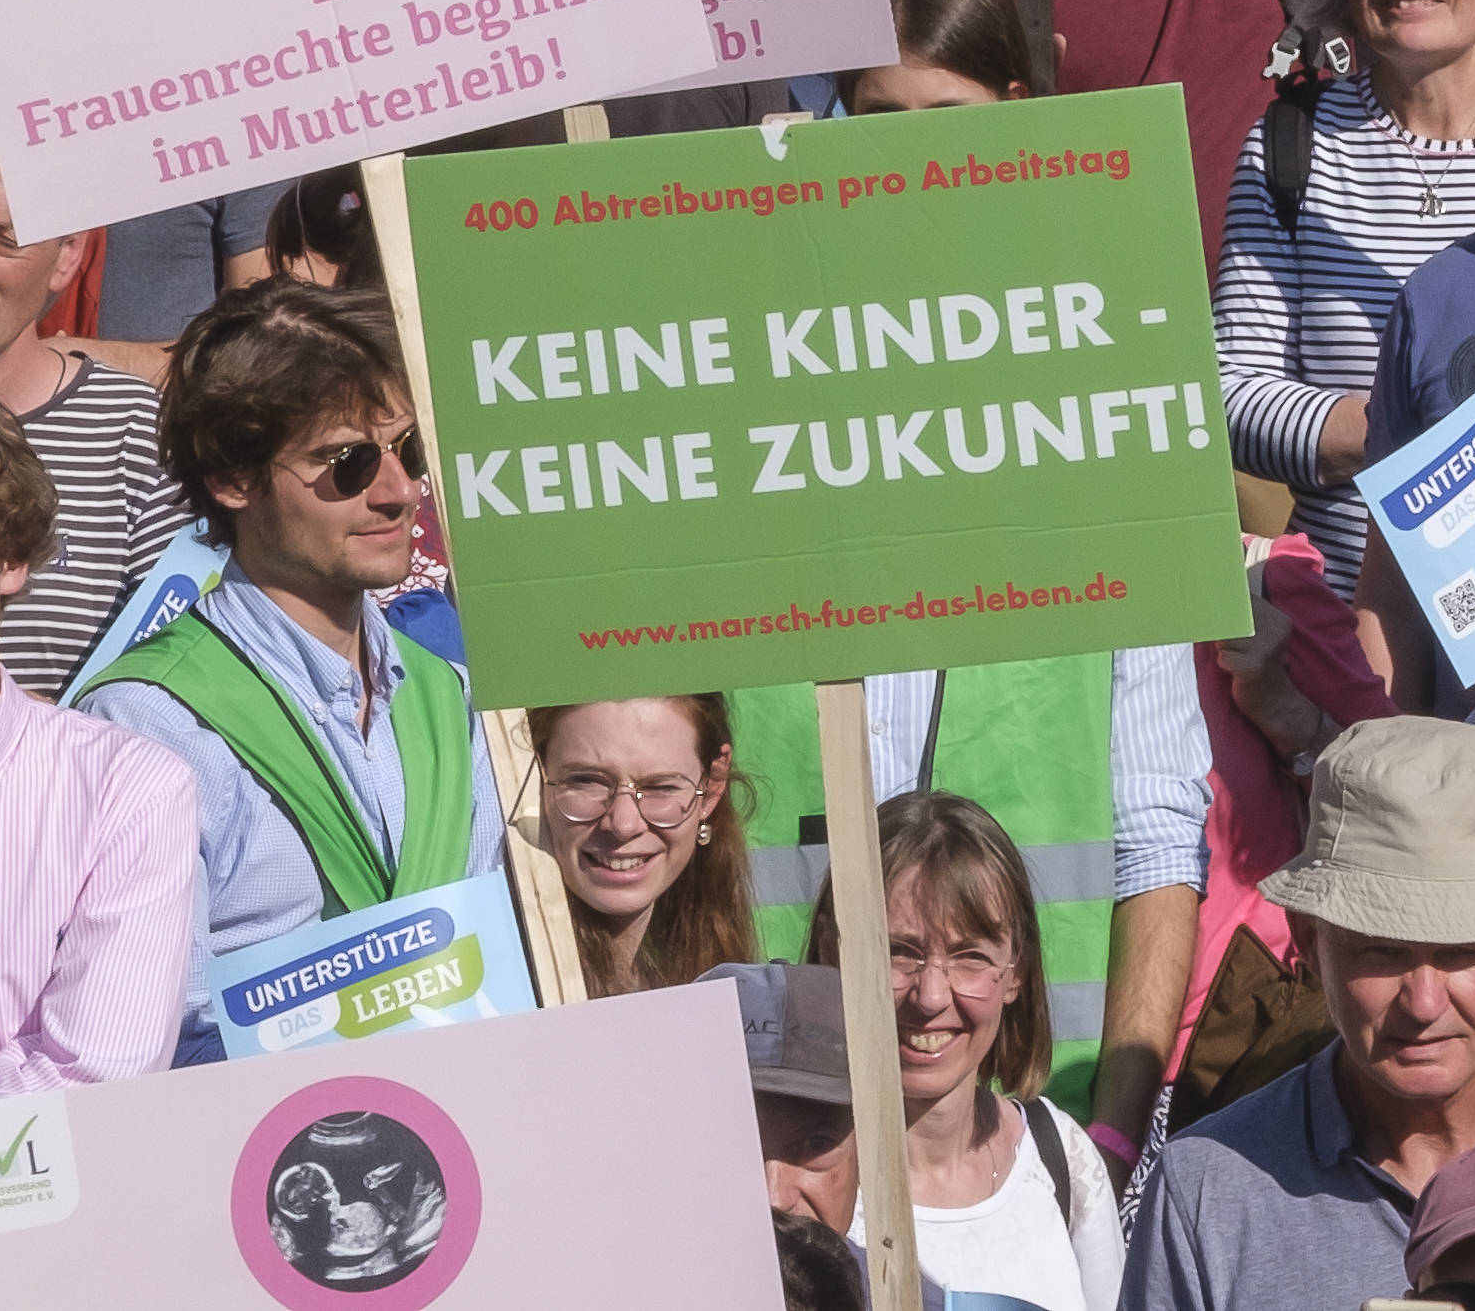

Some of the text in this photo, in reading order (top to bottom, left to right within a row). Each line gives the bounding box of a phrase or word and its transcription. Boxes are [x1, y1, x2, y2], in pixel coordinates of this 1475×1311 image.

[17, 16, 396, 148] Frauenrechte
[153, 38, 569, 184] im Mutterleib!
[464, 146, 1131, 234] 400 Abtreibungen pro Arbeitstag
[471, 281, 1114, 406] KEINE KINDER
[456, 381, 1212, 520] KEINE ZUKUNFT!
[579, 573, 1128, 653] www.marsch-fuer-das-leben.de
[246, 916, 437, 1016] UNTERSTÜTZE
[351, 957, 464, 1027] LEBEN
